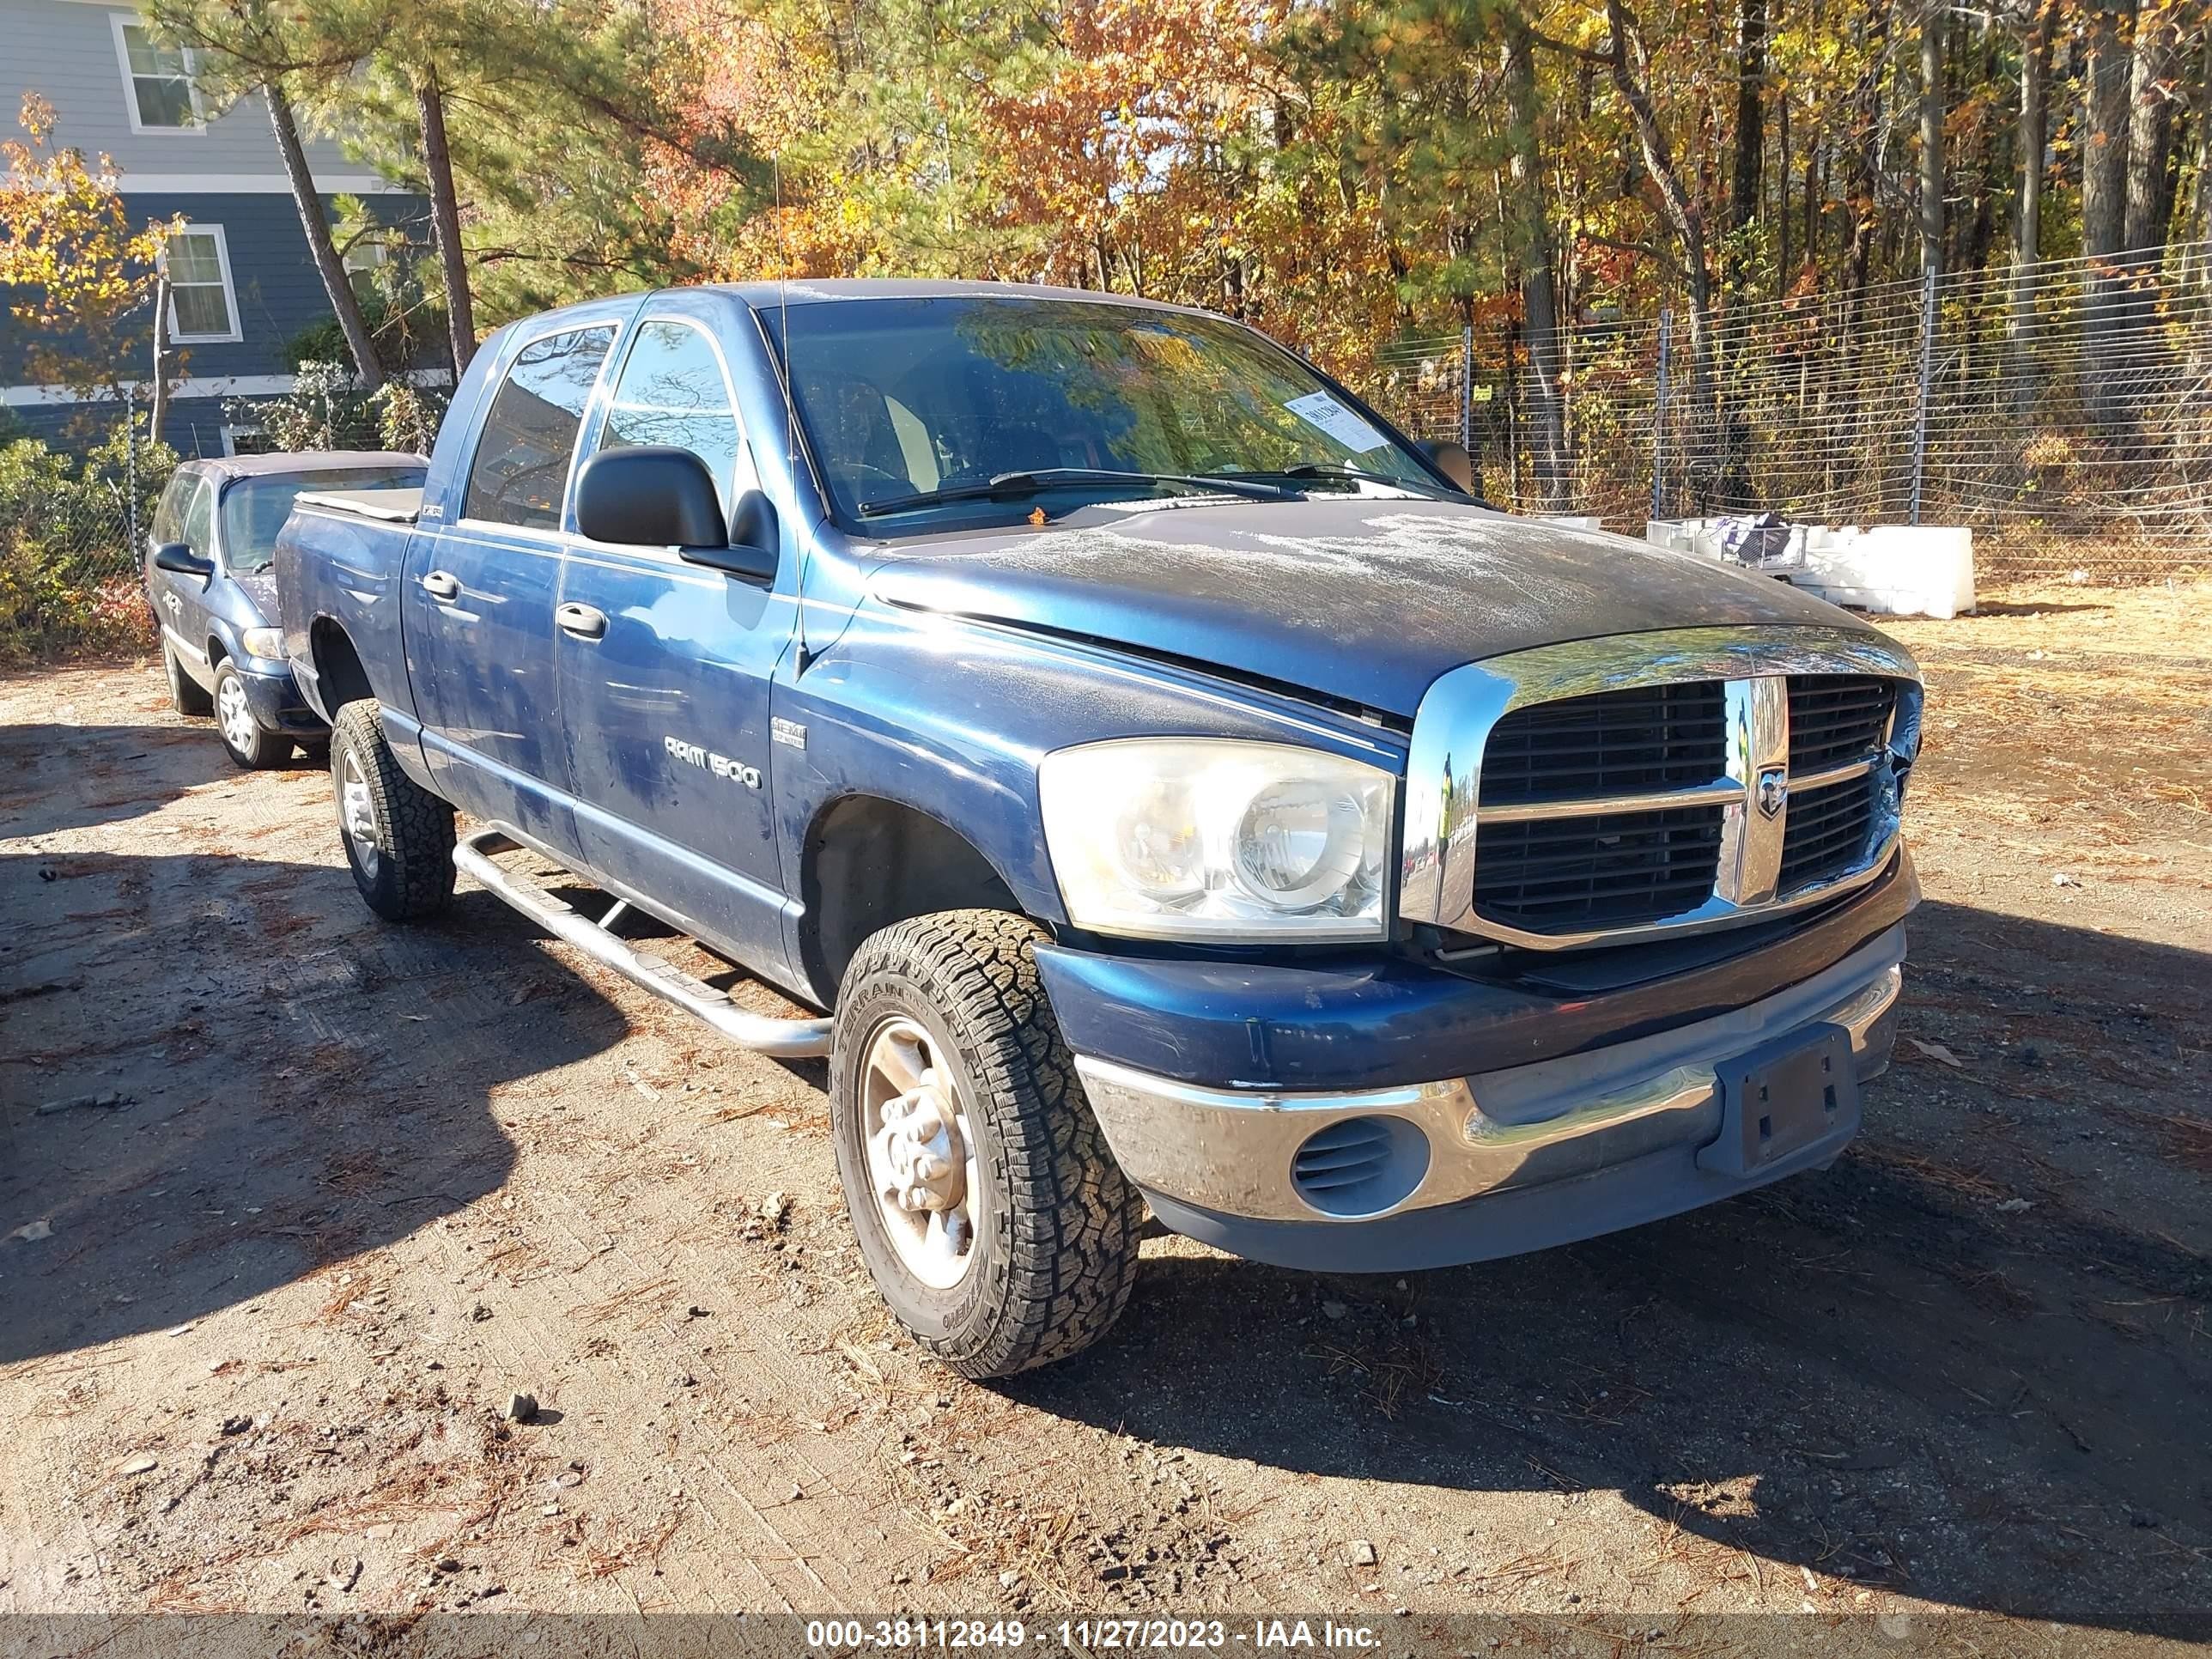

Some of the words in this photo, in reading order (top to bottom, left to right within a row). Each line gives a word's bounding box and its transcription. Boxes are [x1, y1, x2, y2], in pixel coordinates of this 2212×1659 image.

[771, 716, 806, 739] HEMI
[665, 735, 708, 770] RAM
[708, 752, 762, 790] 1500
